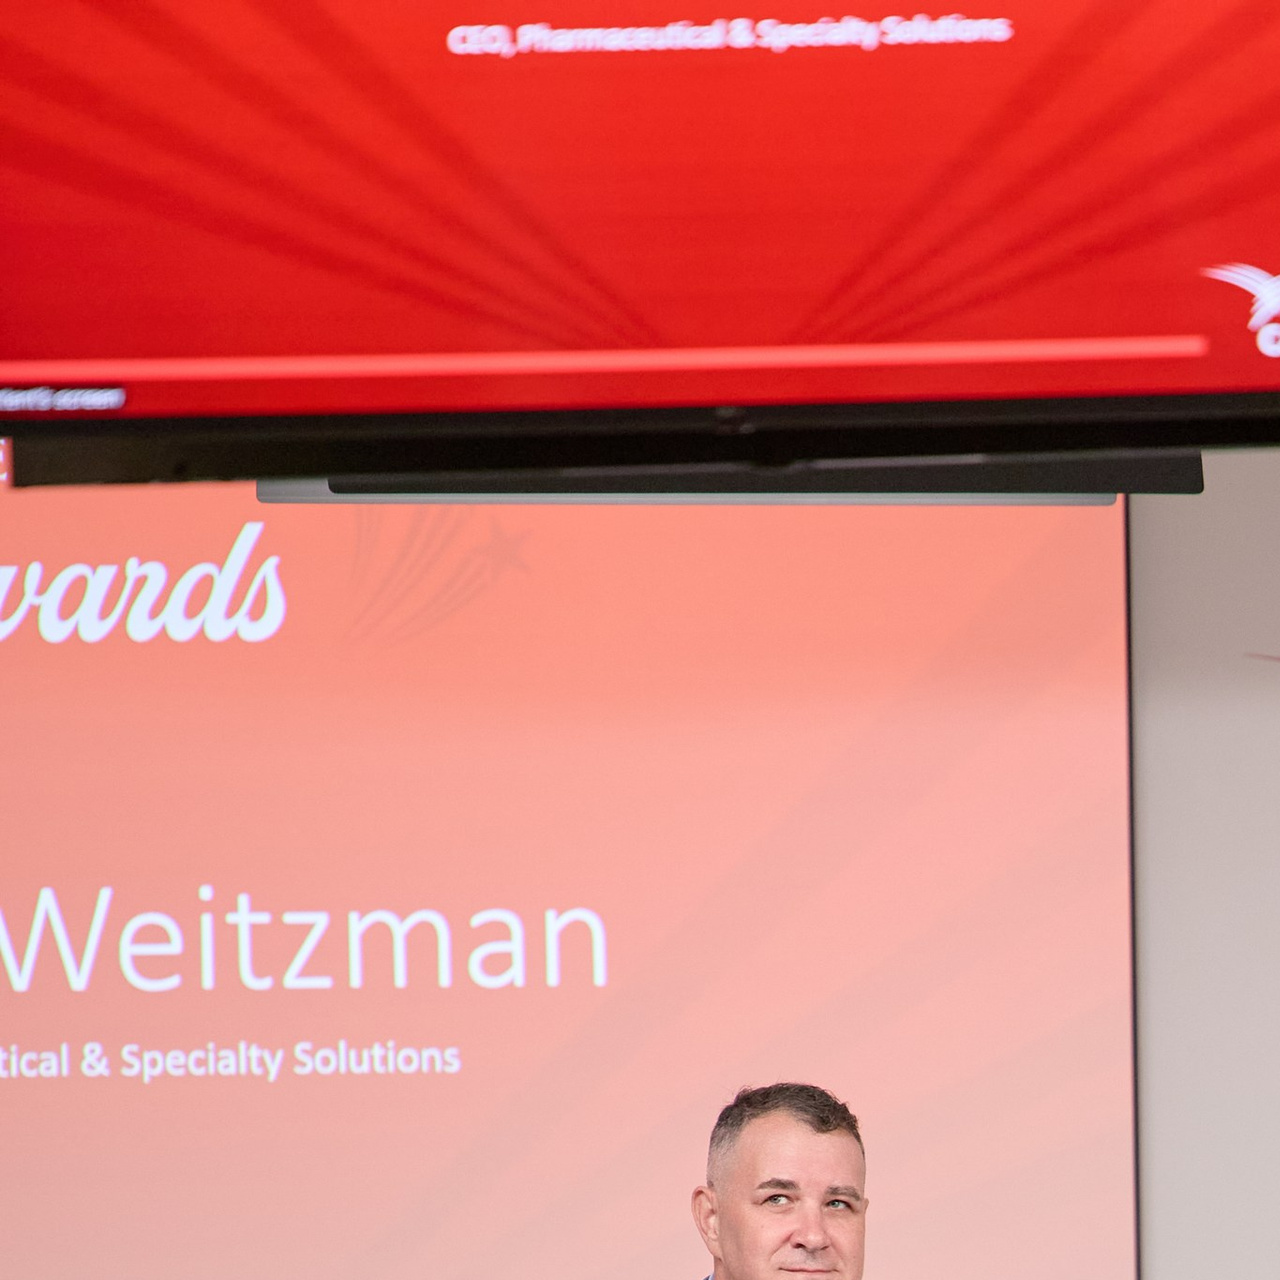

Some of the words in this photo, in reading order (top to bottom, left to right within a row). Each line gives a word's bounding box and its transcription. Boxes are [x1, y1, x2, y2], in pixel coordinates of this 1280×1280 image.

[880, 13, 1014, 45] Solutions
[0, 885, 608, 992] Weitzman
[79, 1042, 109, 1078] &
[120, 1041, 284, 1084] Specialty
[293, 1039, 462, 1075] Solutions
